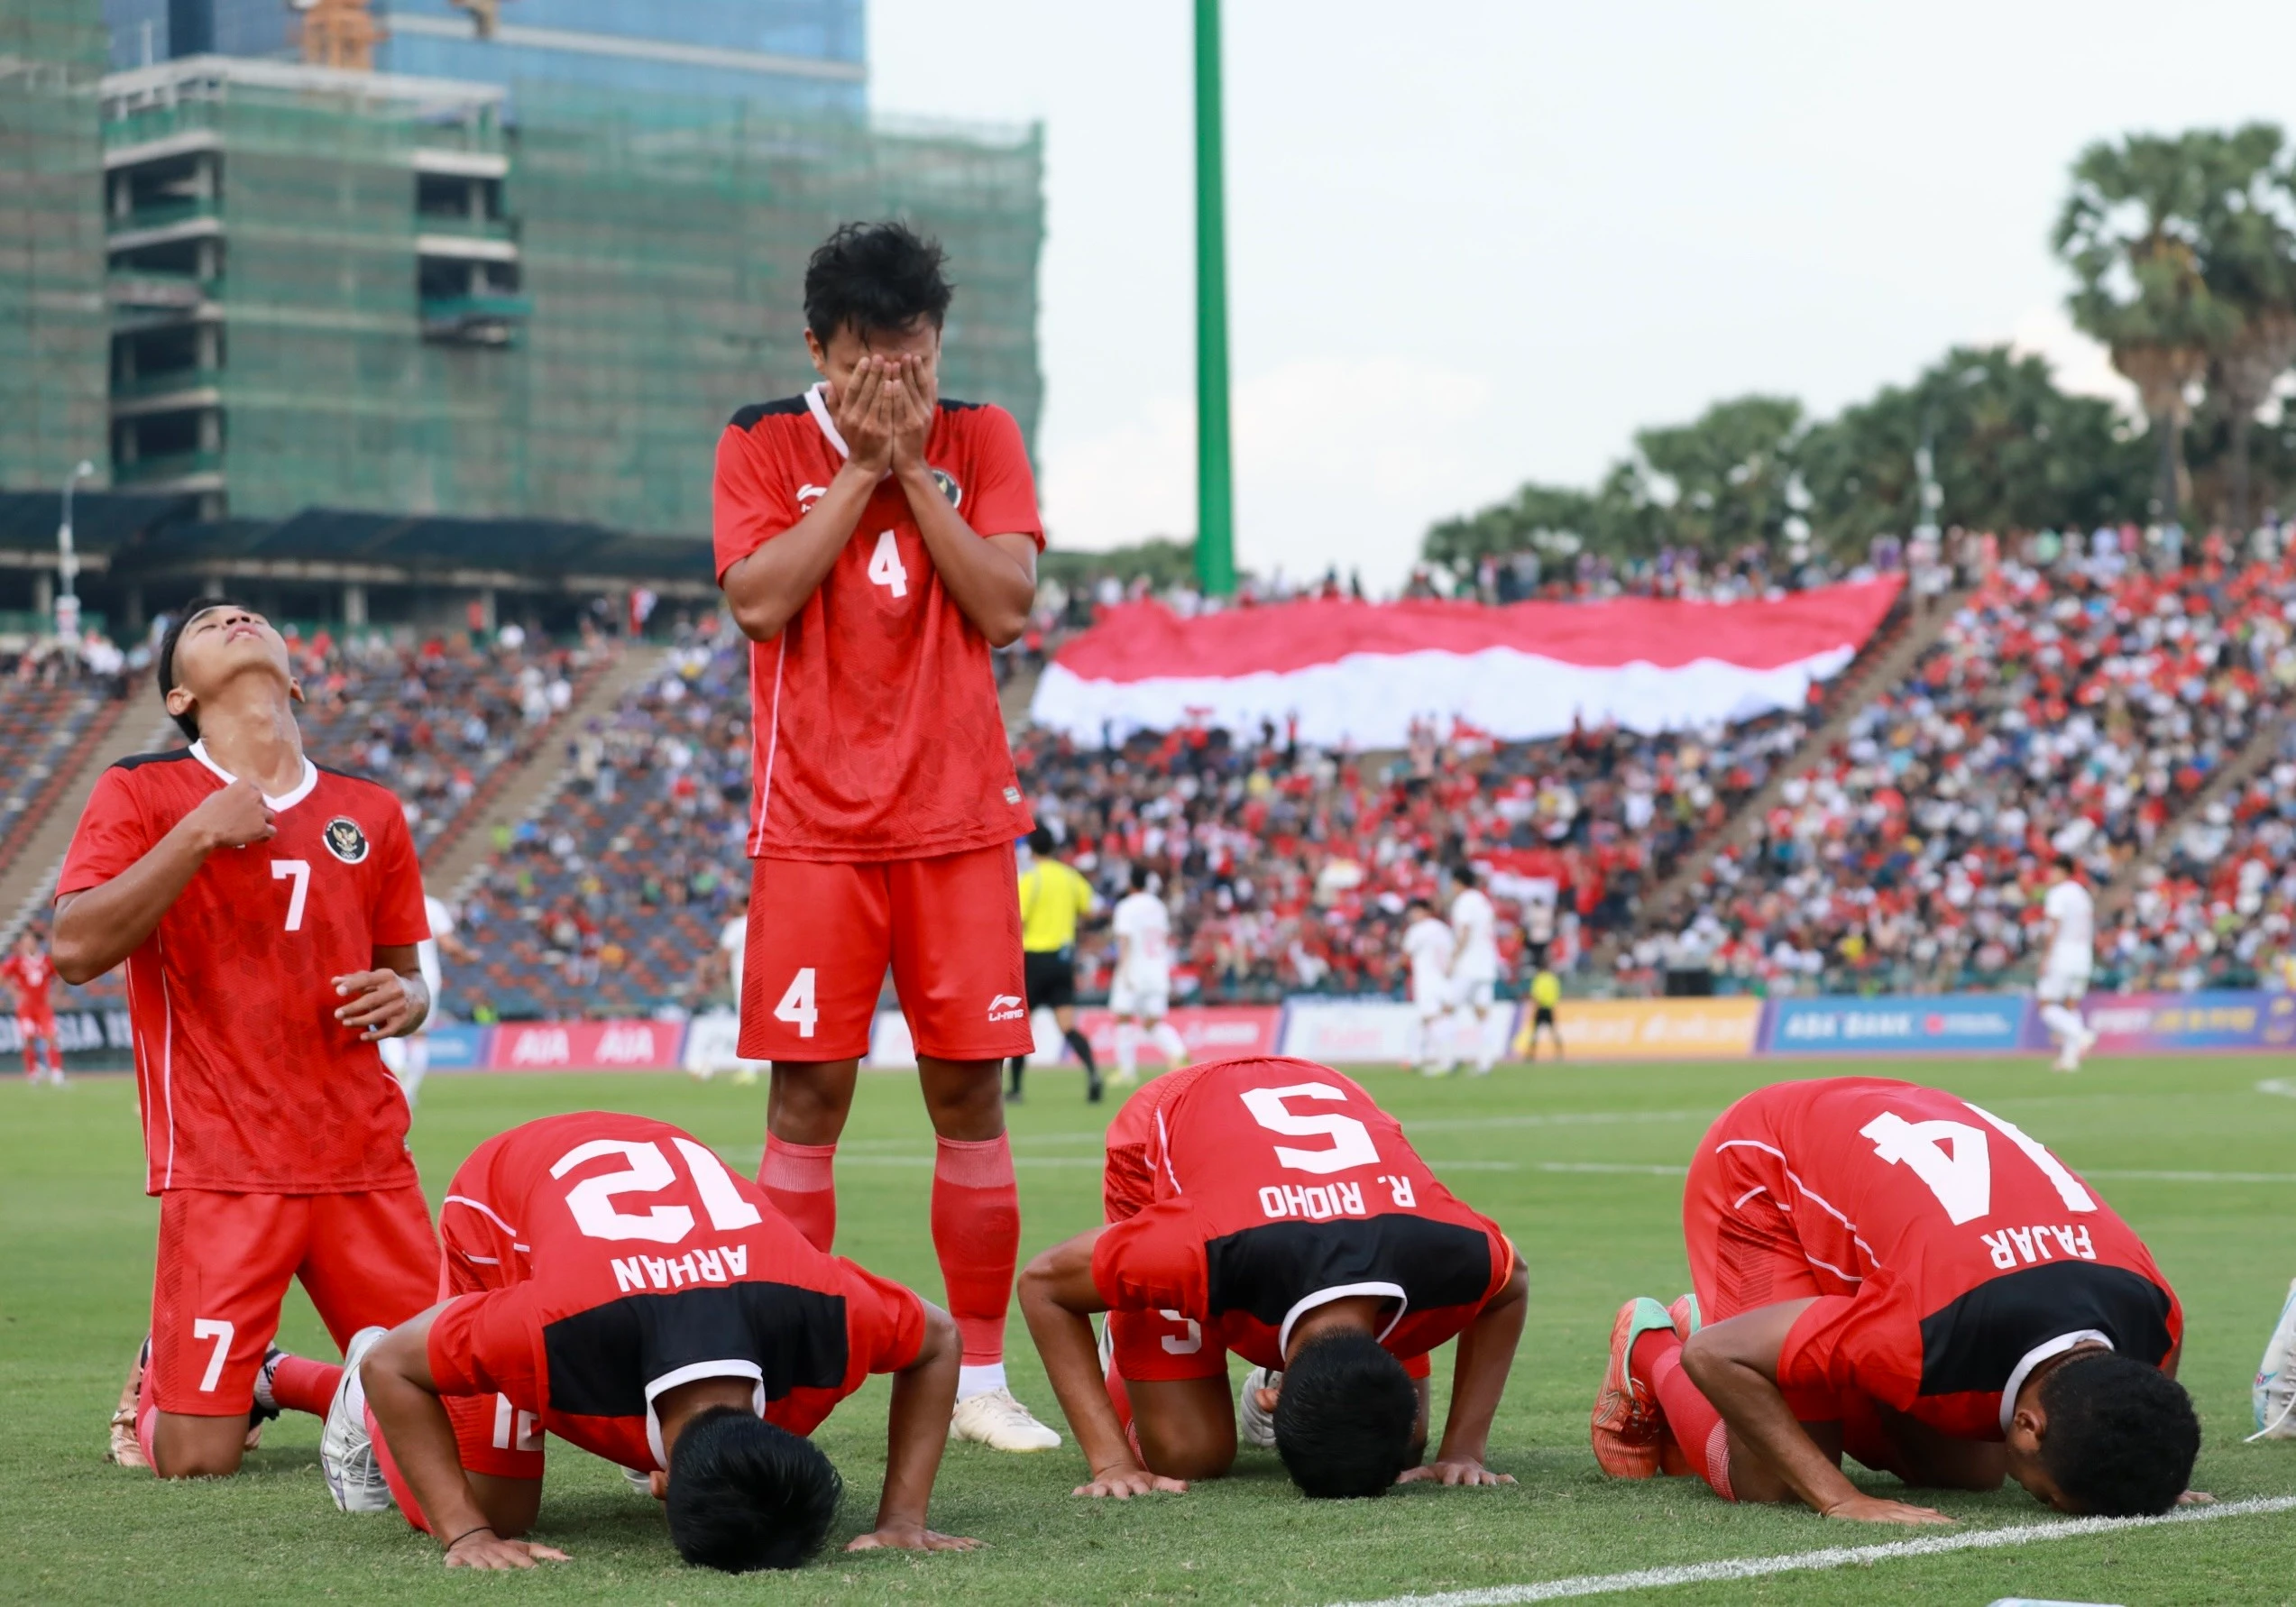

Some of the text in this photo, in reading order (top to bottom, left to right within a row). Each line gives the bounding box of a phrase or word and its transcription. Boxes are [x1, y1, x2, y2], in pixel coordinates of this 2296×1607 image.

[868, 529, 908, 599] 4
[271, 859, 311, 932] 7
[773, 967, 818, 1038] 4
[1239, 1080, 1381, 1175] 5
[548, 1136, 763, 1244] 12
[1258, 1175, 1417, 1220] R. RIDHO
[1858, 1102, 2099, 1226] 14
[610, 1244, 748, 1293] ARHAN
[1979, 1224, 2098, 1270] FAJAR
[193, 1318, 235, 1392] 7
